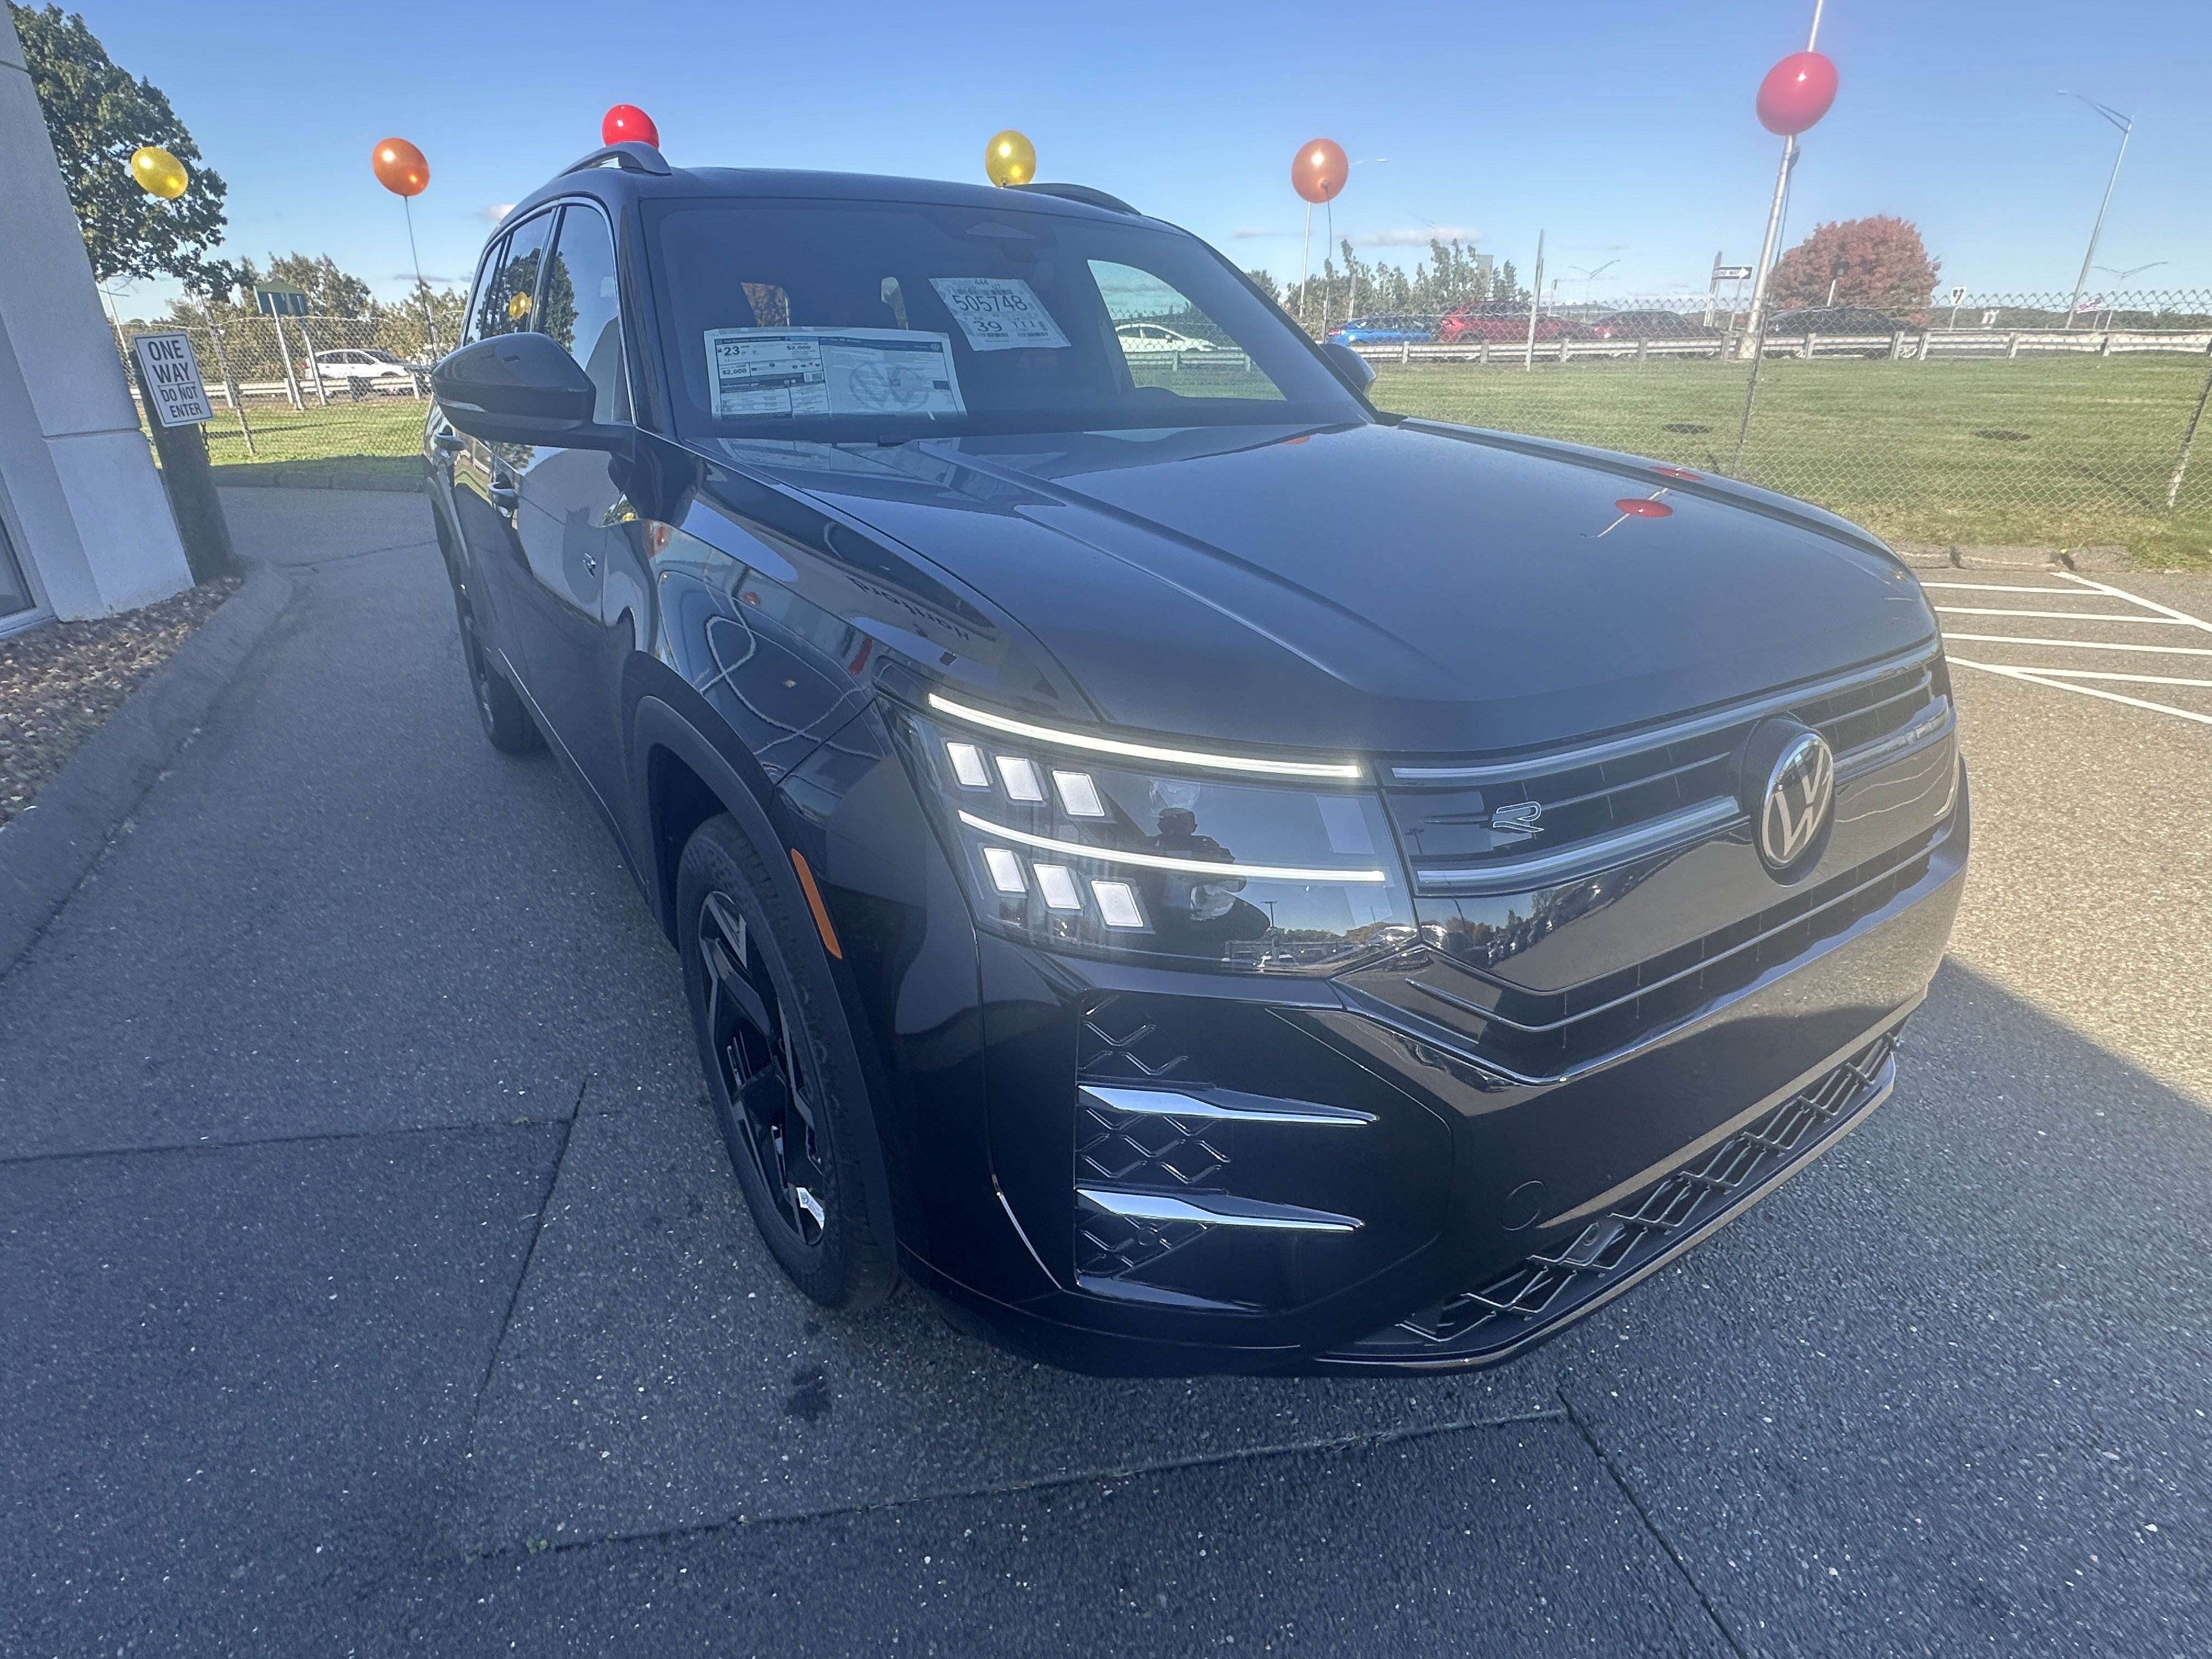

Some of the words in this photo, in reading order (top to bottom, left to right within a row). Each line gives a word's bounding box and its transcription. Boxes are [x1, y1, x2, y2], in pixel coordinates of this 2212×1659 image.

[952, 295, 1028, 312] 505748
[973, 321, 1002, 332] 39
[148, 340, 184, 361] ONE
[724, 346, 740, 356] 23
[152, 363, 190, 383] WAY
[160, 388, 177, 402] DO
[178, 386, 198, 400] NOT
[169, 403, 202, 417] ENTER
[1492, 801, 1545, 833] R
